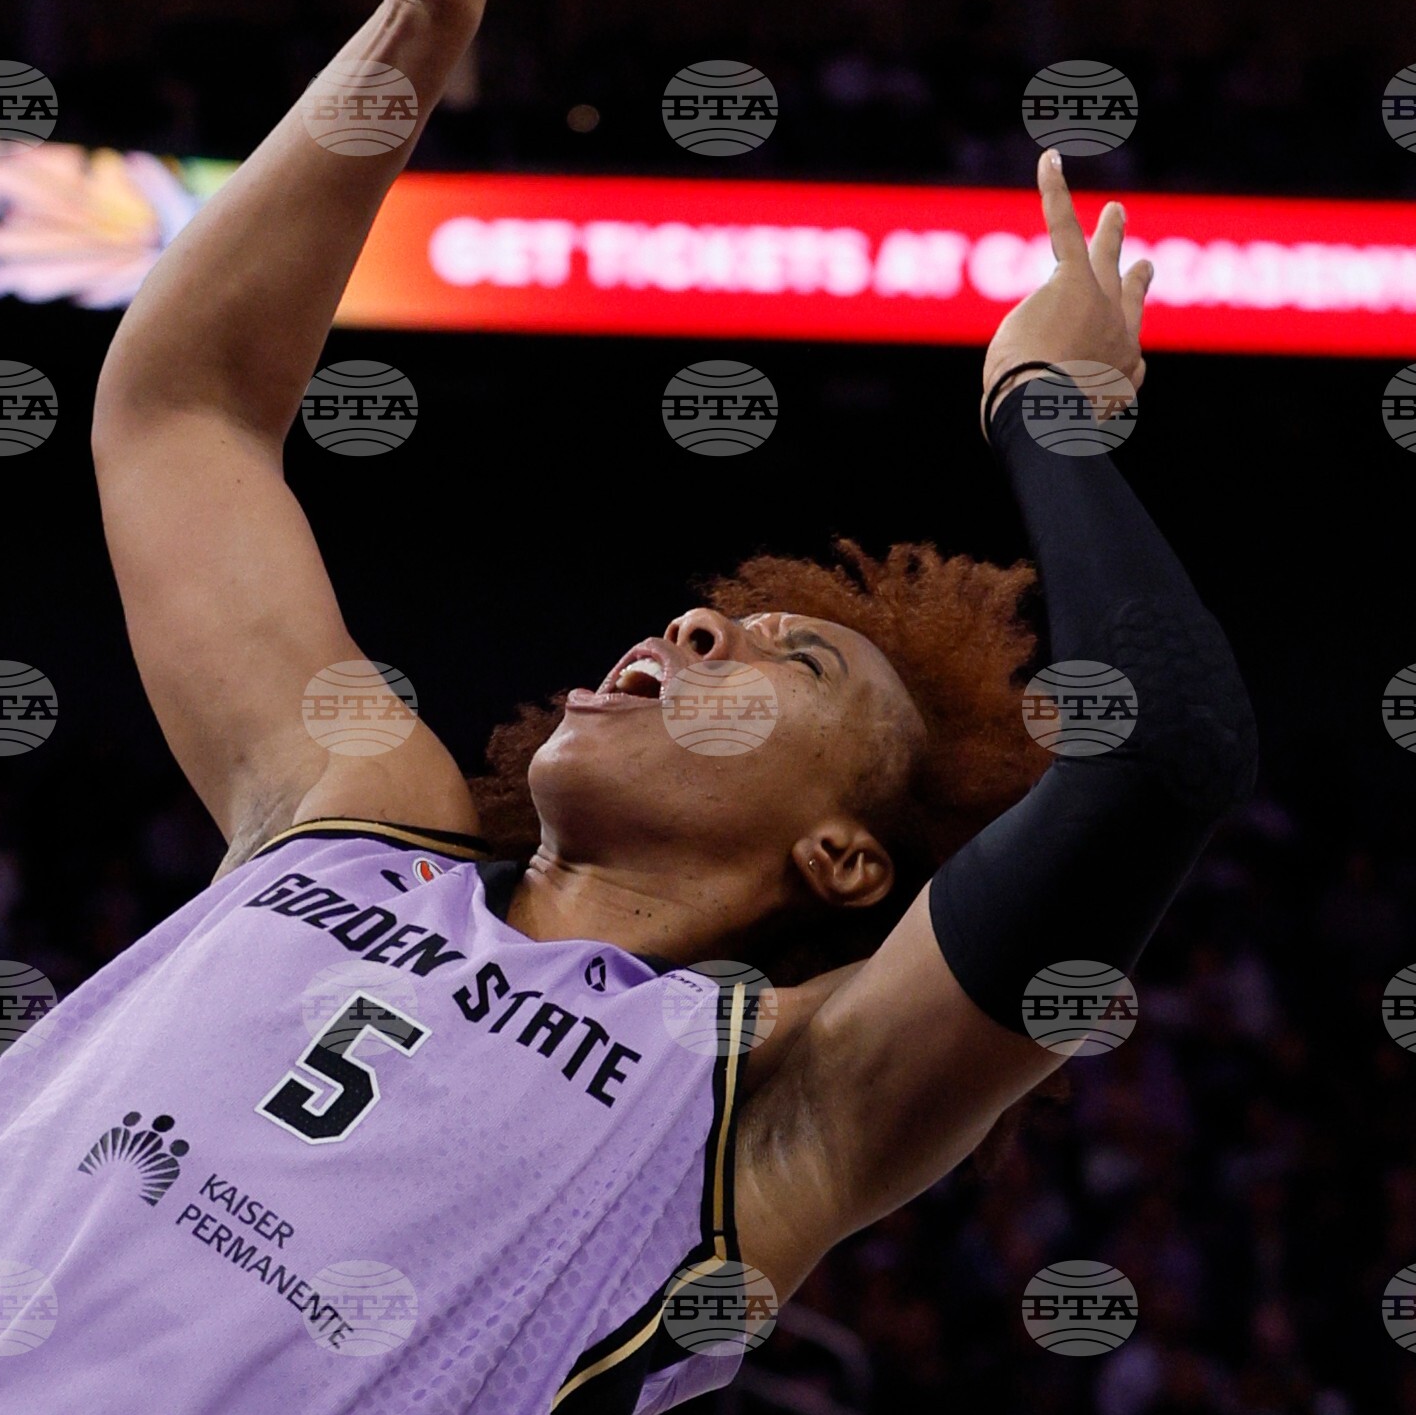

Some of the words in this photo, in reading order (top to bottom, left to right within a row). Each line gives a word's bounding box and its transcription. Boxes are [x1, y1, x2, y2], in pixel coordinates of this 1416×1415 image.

[245, 873, 465, 978] GOLDEN
[451, 962, 642, 1108] STATE
[254, 989, 432, 1145] 5
[175, 1203, 354, 1350] PERMANENTE
[199, 1173, 295, 1249] KAISER
